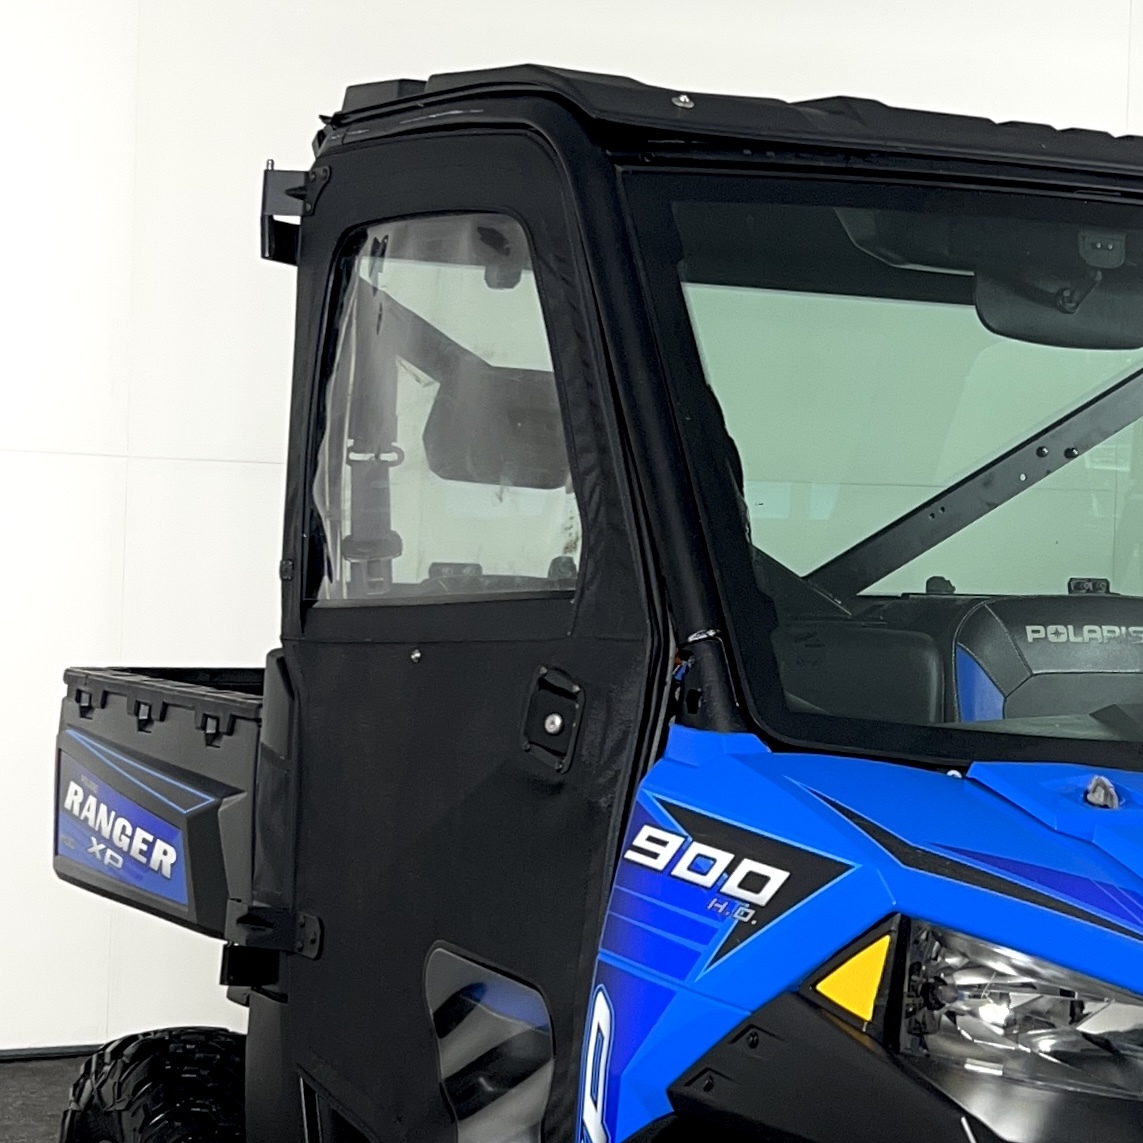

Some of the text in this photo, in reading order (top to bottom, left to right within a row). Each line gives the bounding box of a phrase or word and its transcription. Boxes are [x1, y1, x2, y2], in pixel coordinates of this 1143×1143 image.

[63, 780, 178, 879] RANGER
[86, 836, 124, 870] XP
[623, 824, 791, 907] 900
